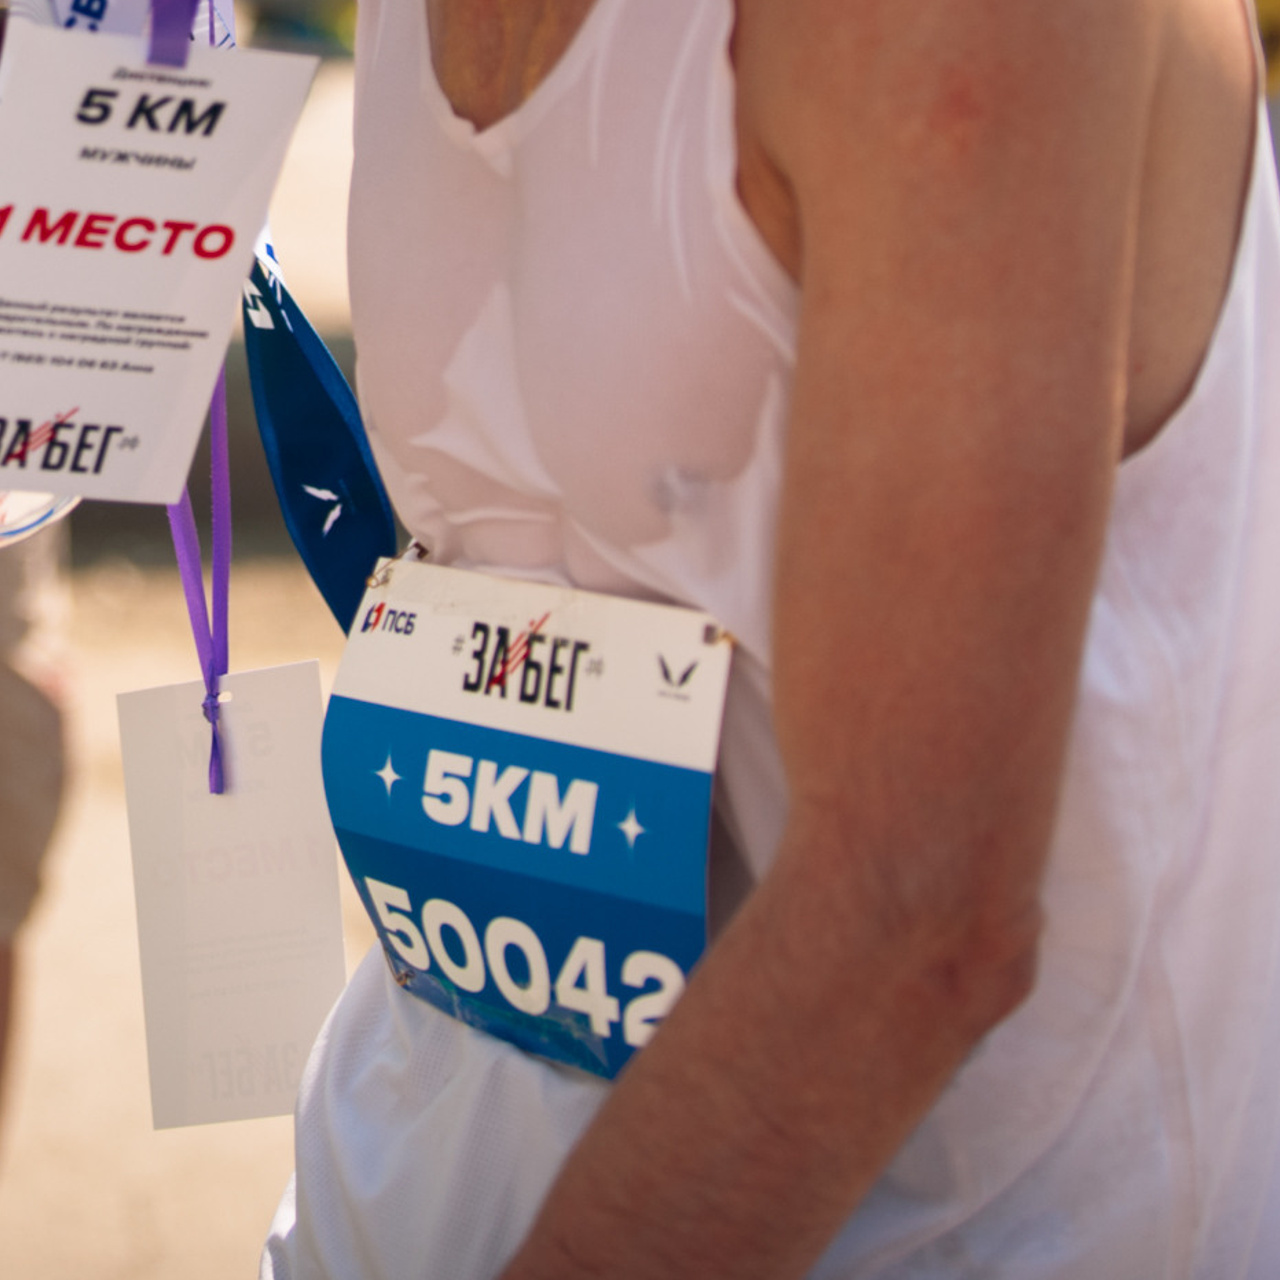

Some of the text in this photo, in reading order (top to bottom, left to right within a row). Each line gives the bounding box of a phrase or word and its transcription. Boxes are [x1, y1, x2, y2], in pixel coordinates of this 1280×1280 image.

[75, 86, 227, 139] 5 КМ
[20, 206, 236, 261] МЕСТО
[381, 608, 417, 636] ПСБ
[364, 875, 686, 1049] 50042
